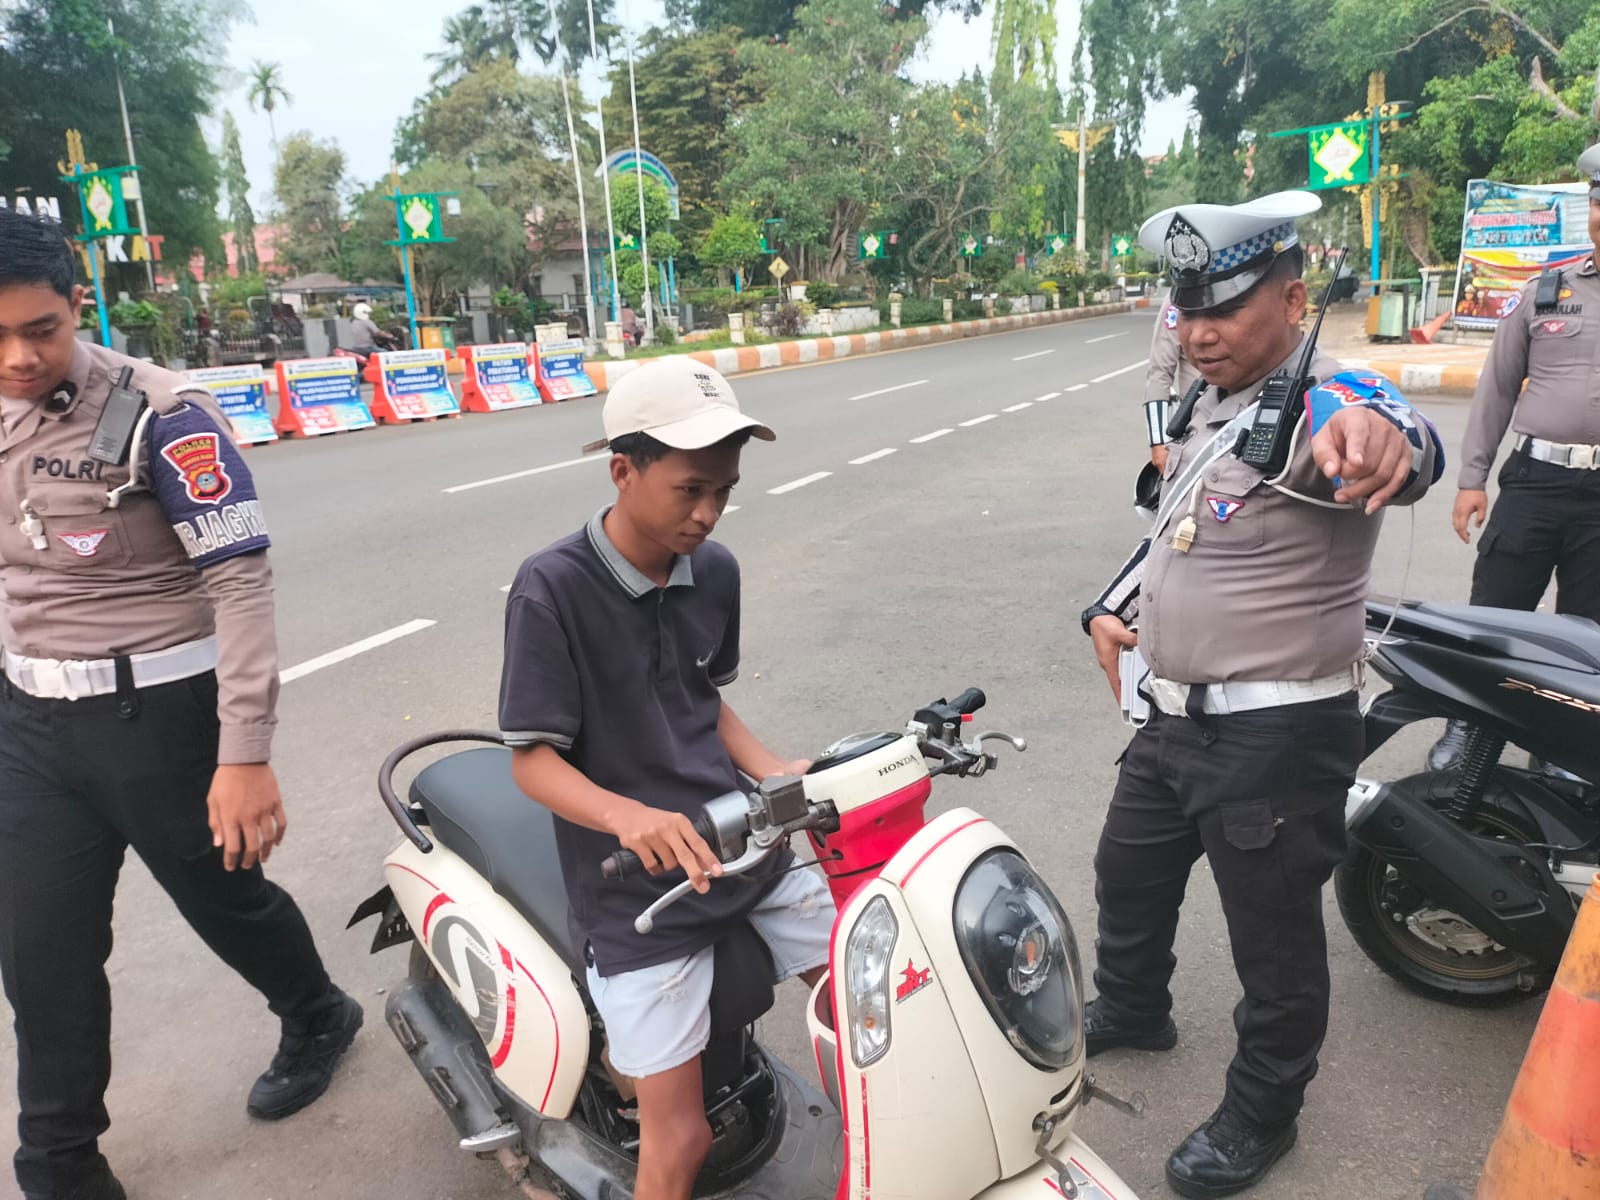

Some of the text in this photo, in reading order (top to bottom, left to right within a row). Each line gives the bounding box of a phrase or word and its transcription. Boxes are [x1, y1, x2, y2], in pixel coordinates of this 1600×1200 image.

[0, 196, 62, 223] AN
[104, 233, 165, 262] KAT
[32, 456, 103, 480] POLRI
[878, 755, 918, 776] HONDA
